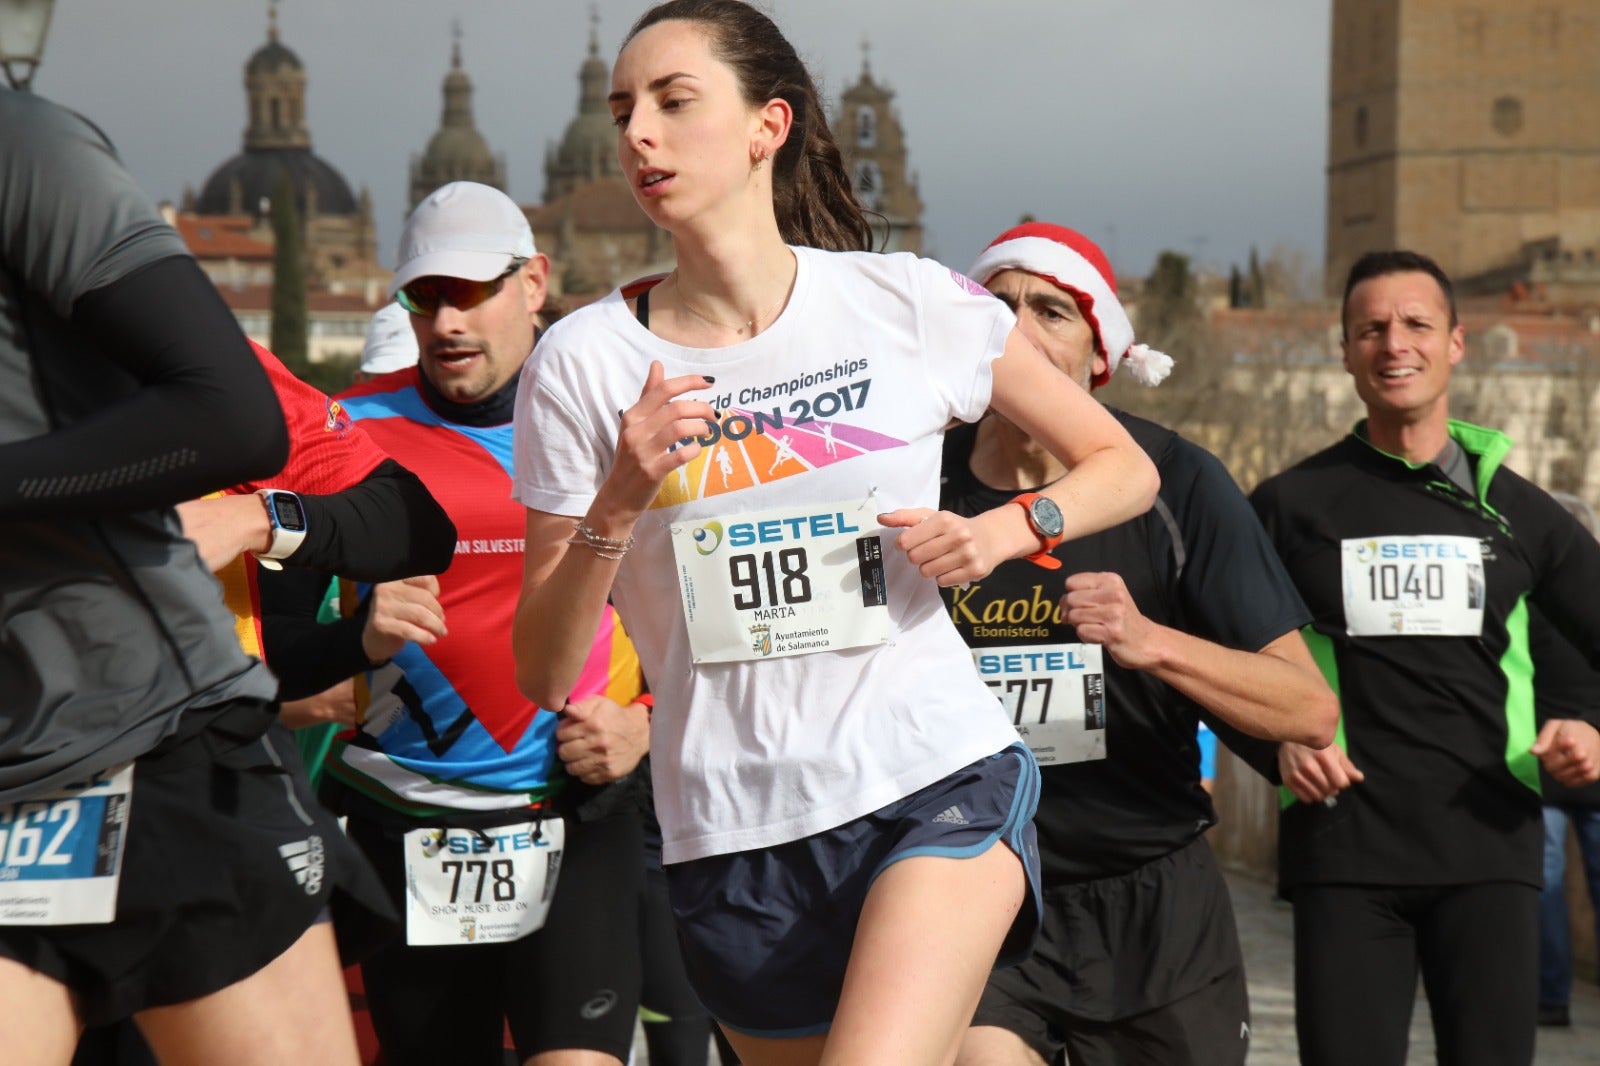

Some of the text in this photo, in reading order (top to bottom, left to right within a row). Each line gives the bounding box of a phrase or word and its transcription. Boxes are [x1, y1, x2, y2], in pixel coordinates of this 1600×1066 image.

[739, 358, 868, 405] Championships
[789, 378, 872, 426] 2017
[727, 512, 860, 547] SETEL
[454, 538, 526, 554] AN SILVESTR
[1381, 543, 1468, 559] SETEL
[728, 547, 812, 611] 918
[1369, 564, 1444, 601] 1040
[754, 606, 796, 622] MARTA
[775, 628, 829, 642] Ayuntamiento
[776, 639, 830, 652] de Salamanca
[979, 651, 1085, 675] SETEL
[931, 815, 970, 825] adidas
[441, 859, 516, 904] 778
[432, 901, 528, 915] SHOW MUST GO ON
